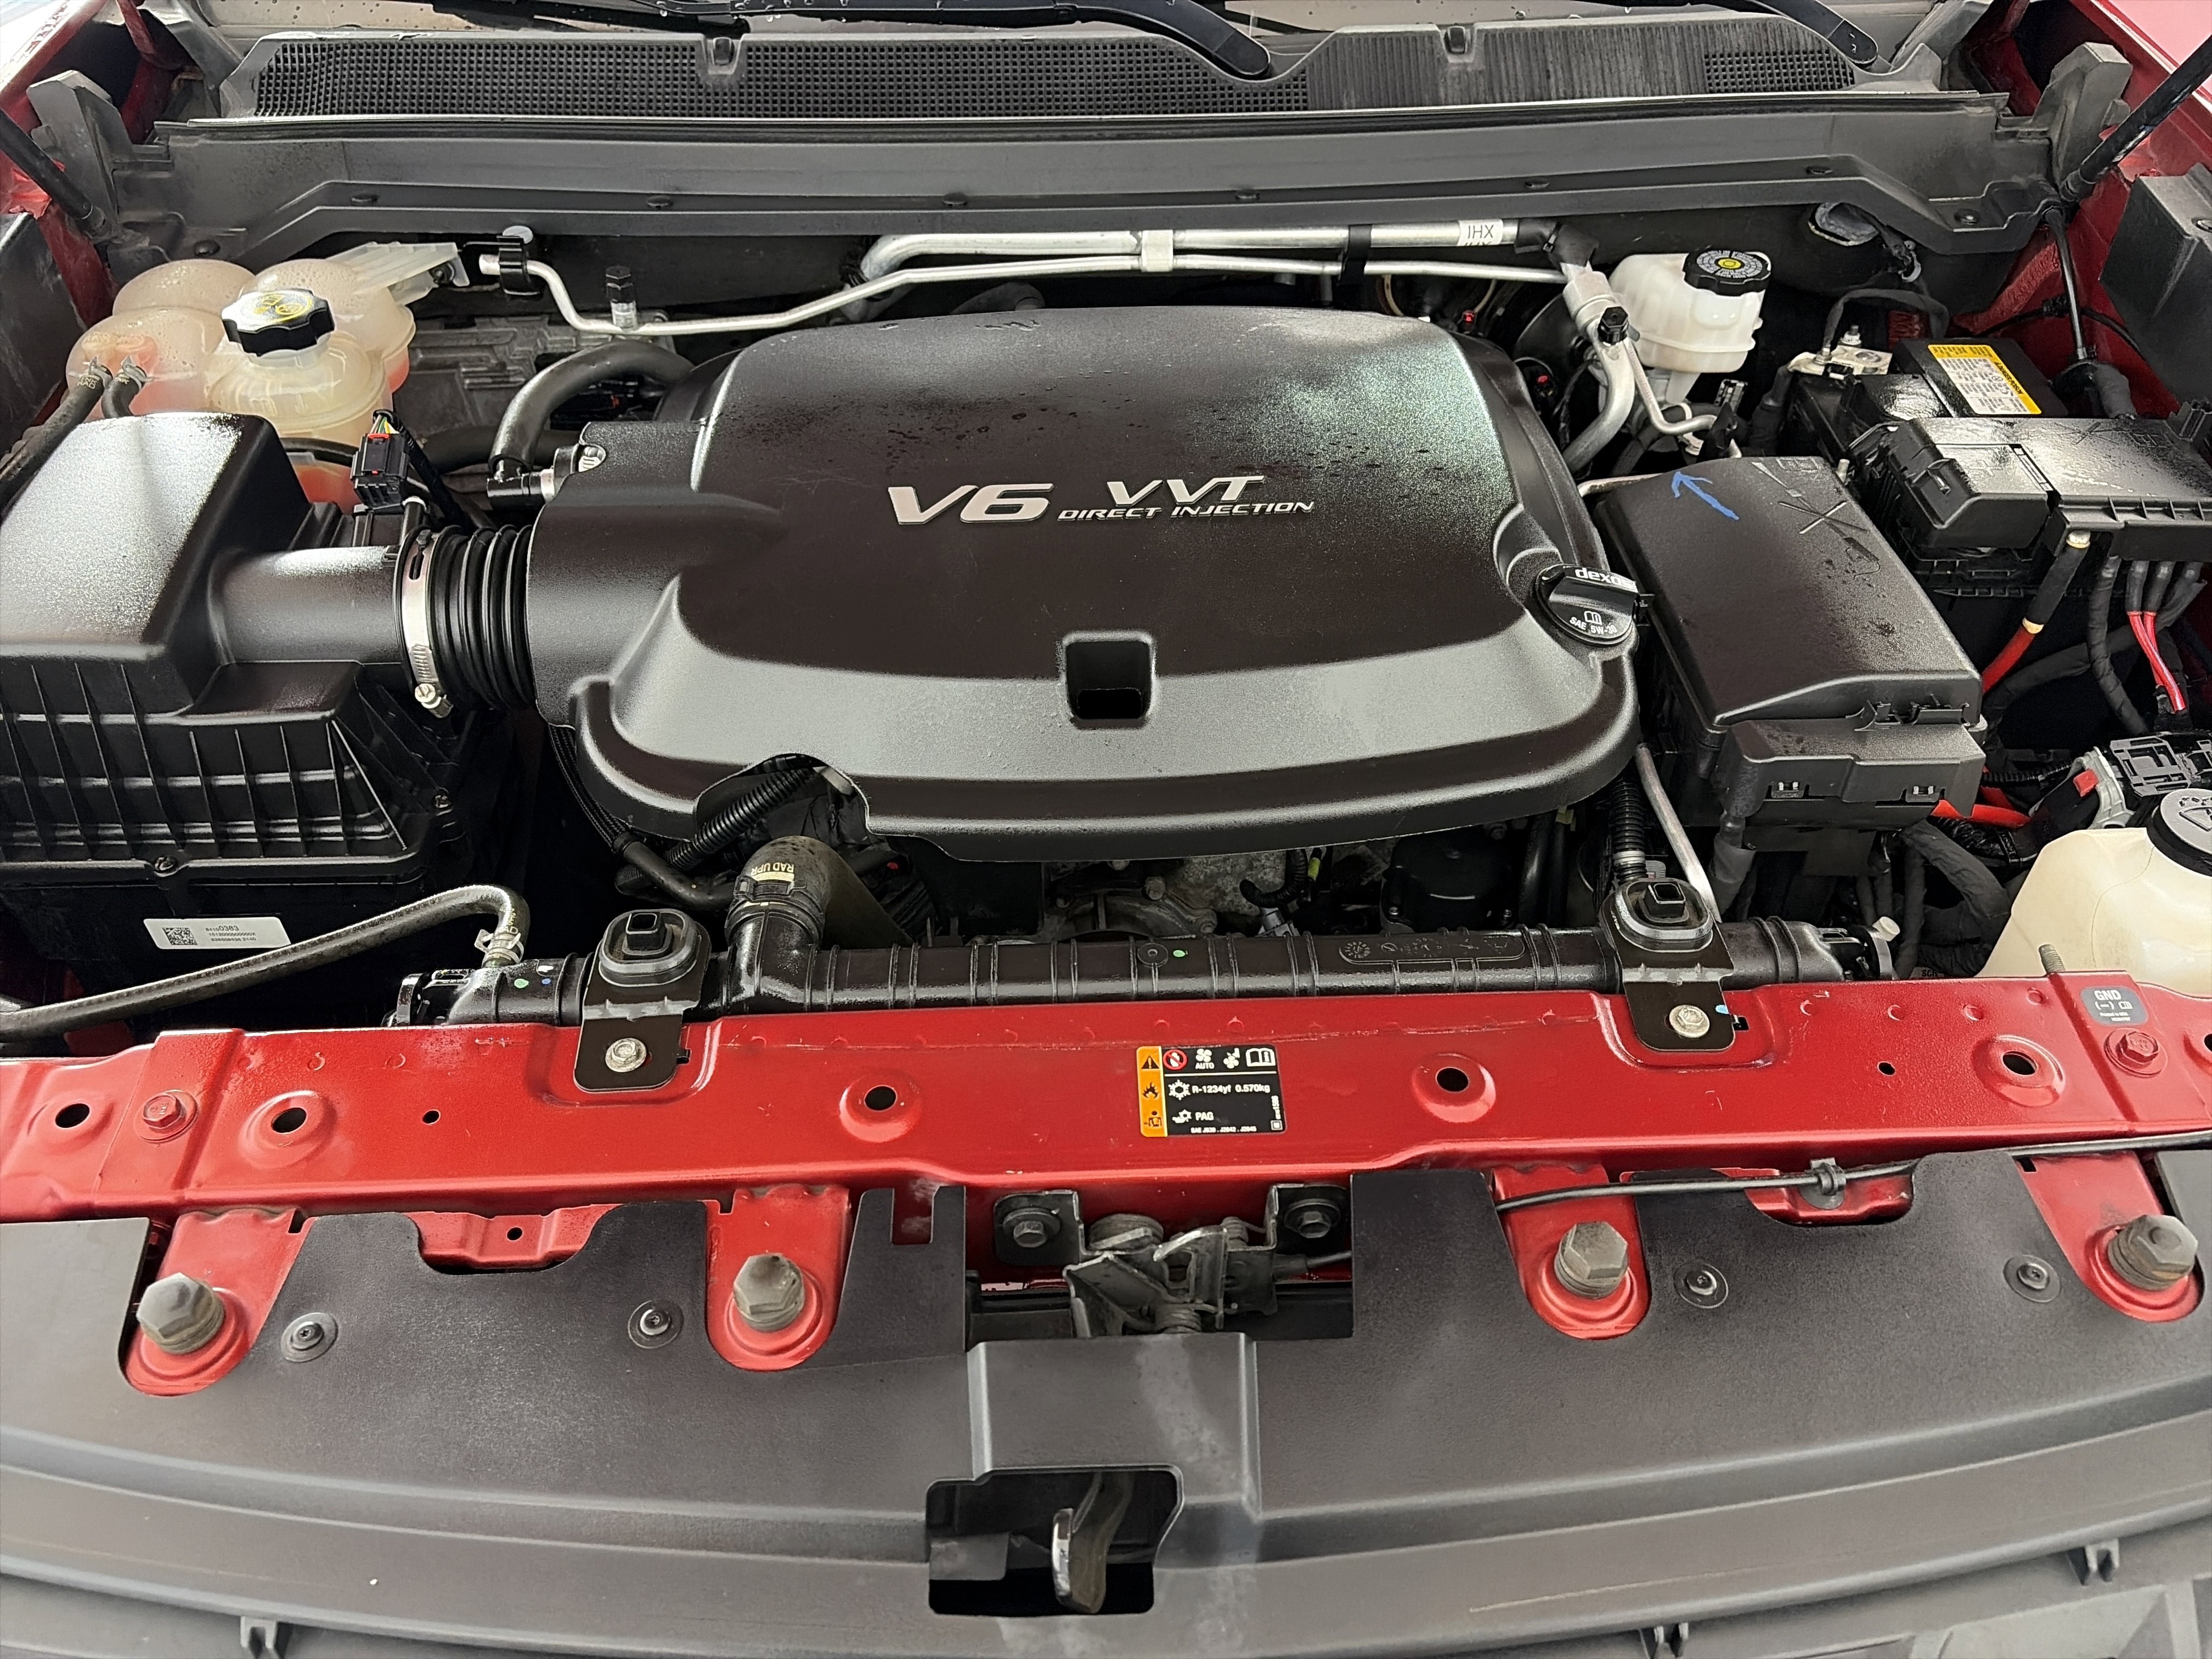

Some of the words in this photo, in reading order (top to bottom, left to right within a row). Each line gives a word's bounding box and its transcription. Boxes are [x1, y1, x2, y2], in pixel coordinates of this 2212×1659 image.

[1468, 224, 1494, 239] IHX
[1106, 475, 1266, 506] VVT
[888, 483, 1054, 525] V6
[1057, 507, 1163, 521] DIRECT
[1170, 500, 1315, 518] INJECTION
[1575, 567, 1635, 590] dexos
[1569, 617, 1587, 630] SAE
[1590, 624, 1618, 635] 5W-30
[751, 862, 771, 876] UPR
[772, 862, 794, 873] RAD
[2094, 990, 2121, 1001] GND
[1192, 1085, 1232, 1094] R-1234yf
[1235, 1084, 1271, 1093] 0.570kg
[1195, 1111, 1214, 1121] PAG
